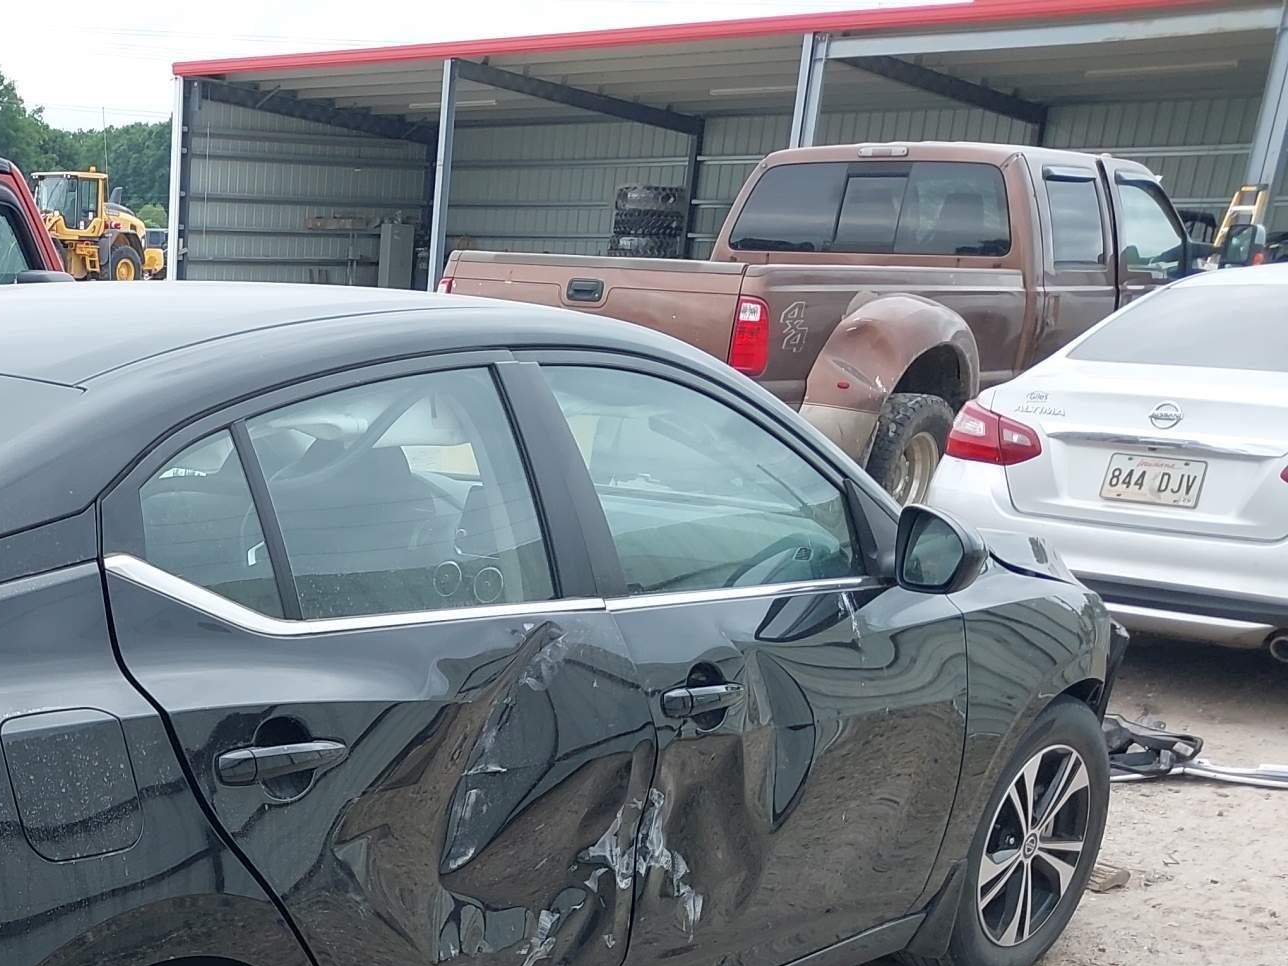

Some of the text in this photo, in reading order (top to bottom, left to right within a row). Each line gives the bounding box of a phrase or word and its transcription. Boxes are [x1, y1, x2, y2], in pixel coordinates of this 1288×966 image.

[1015, 404, 1066, 417] ALTIMA
[1108, 467, 1197, 496] 844 DJV
